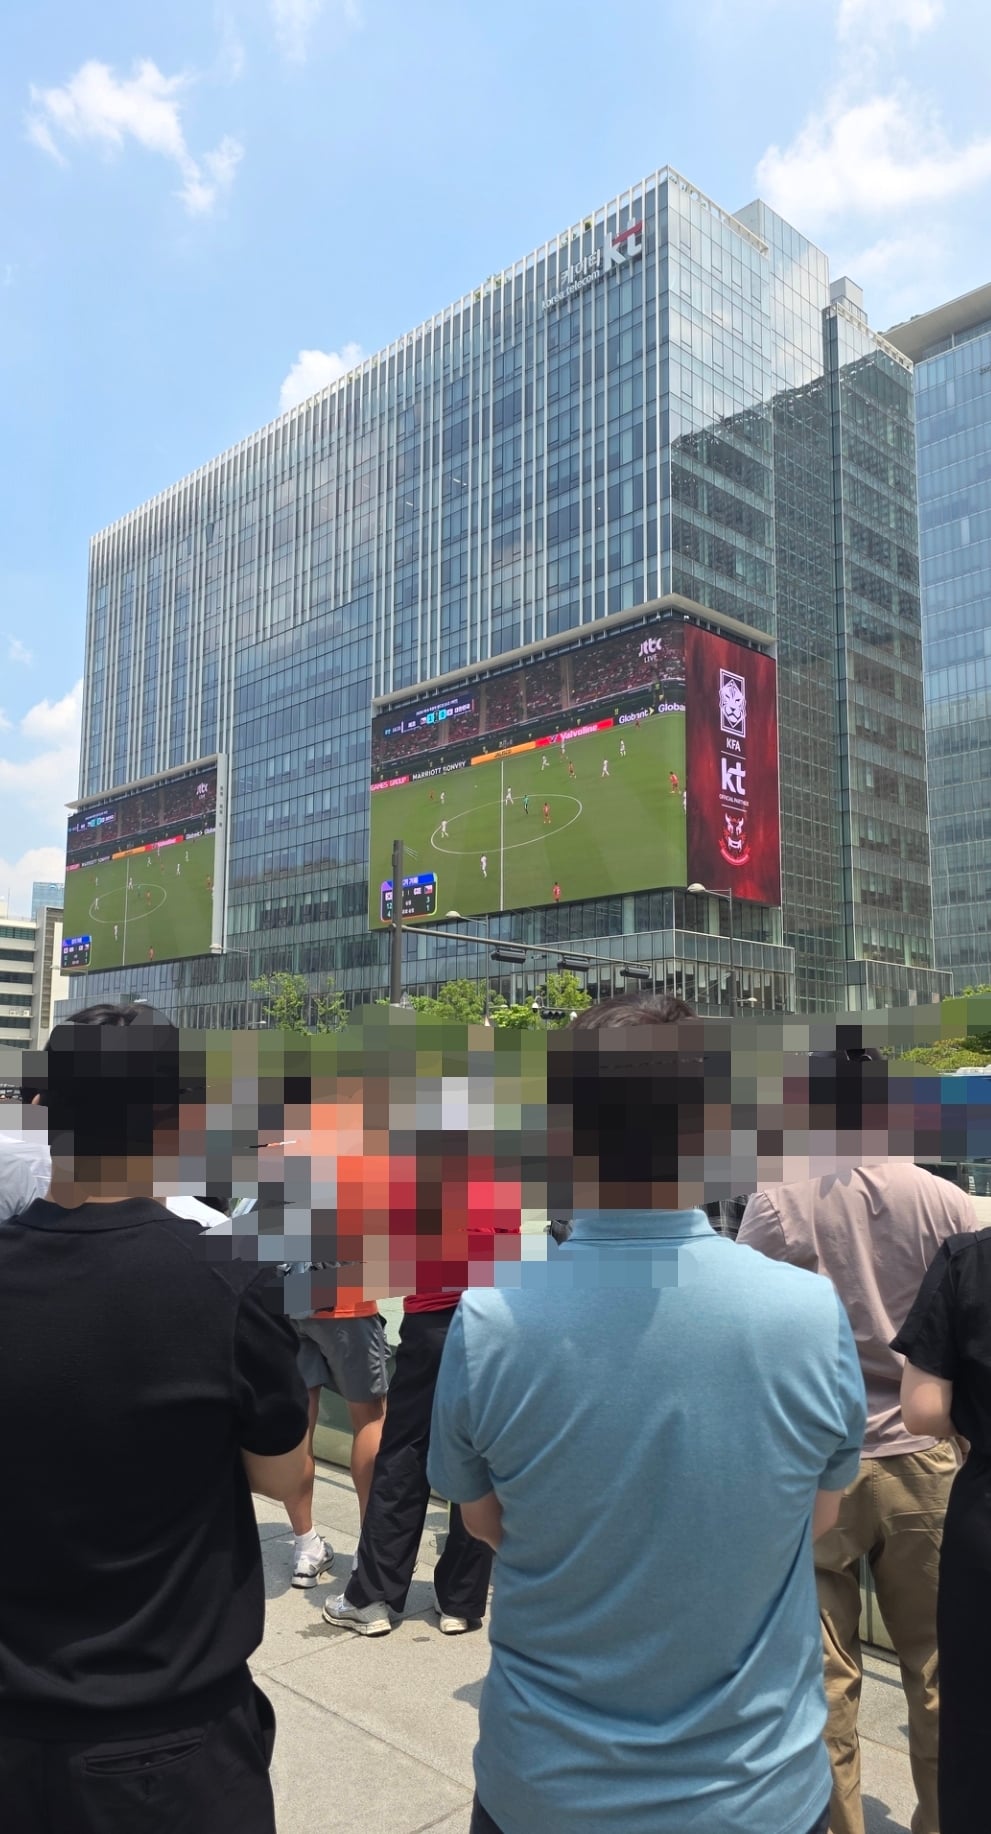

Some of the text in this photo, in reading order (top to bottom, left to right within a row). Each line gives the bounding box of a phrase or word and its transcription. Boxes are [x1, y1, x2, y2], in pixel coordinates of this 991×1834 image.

[603, 217, 642, 273] kt
[560, 248, 600, 284] 케이티
[541, 269, 600, 311] korea telecom
[560, 724, 598, 741] Valvoline
[726, 737, 742, 752] KFA
[412, 767, 442, 781] MARRIOTT
[721, 757, 747, 796] kt
